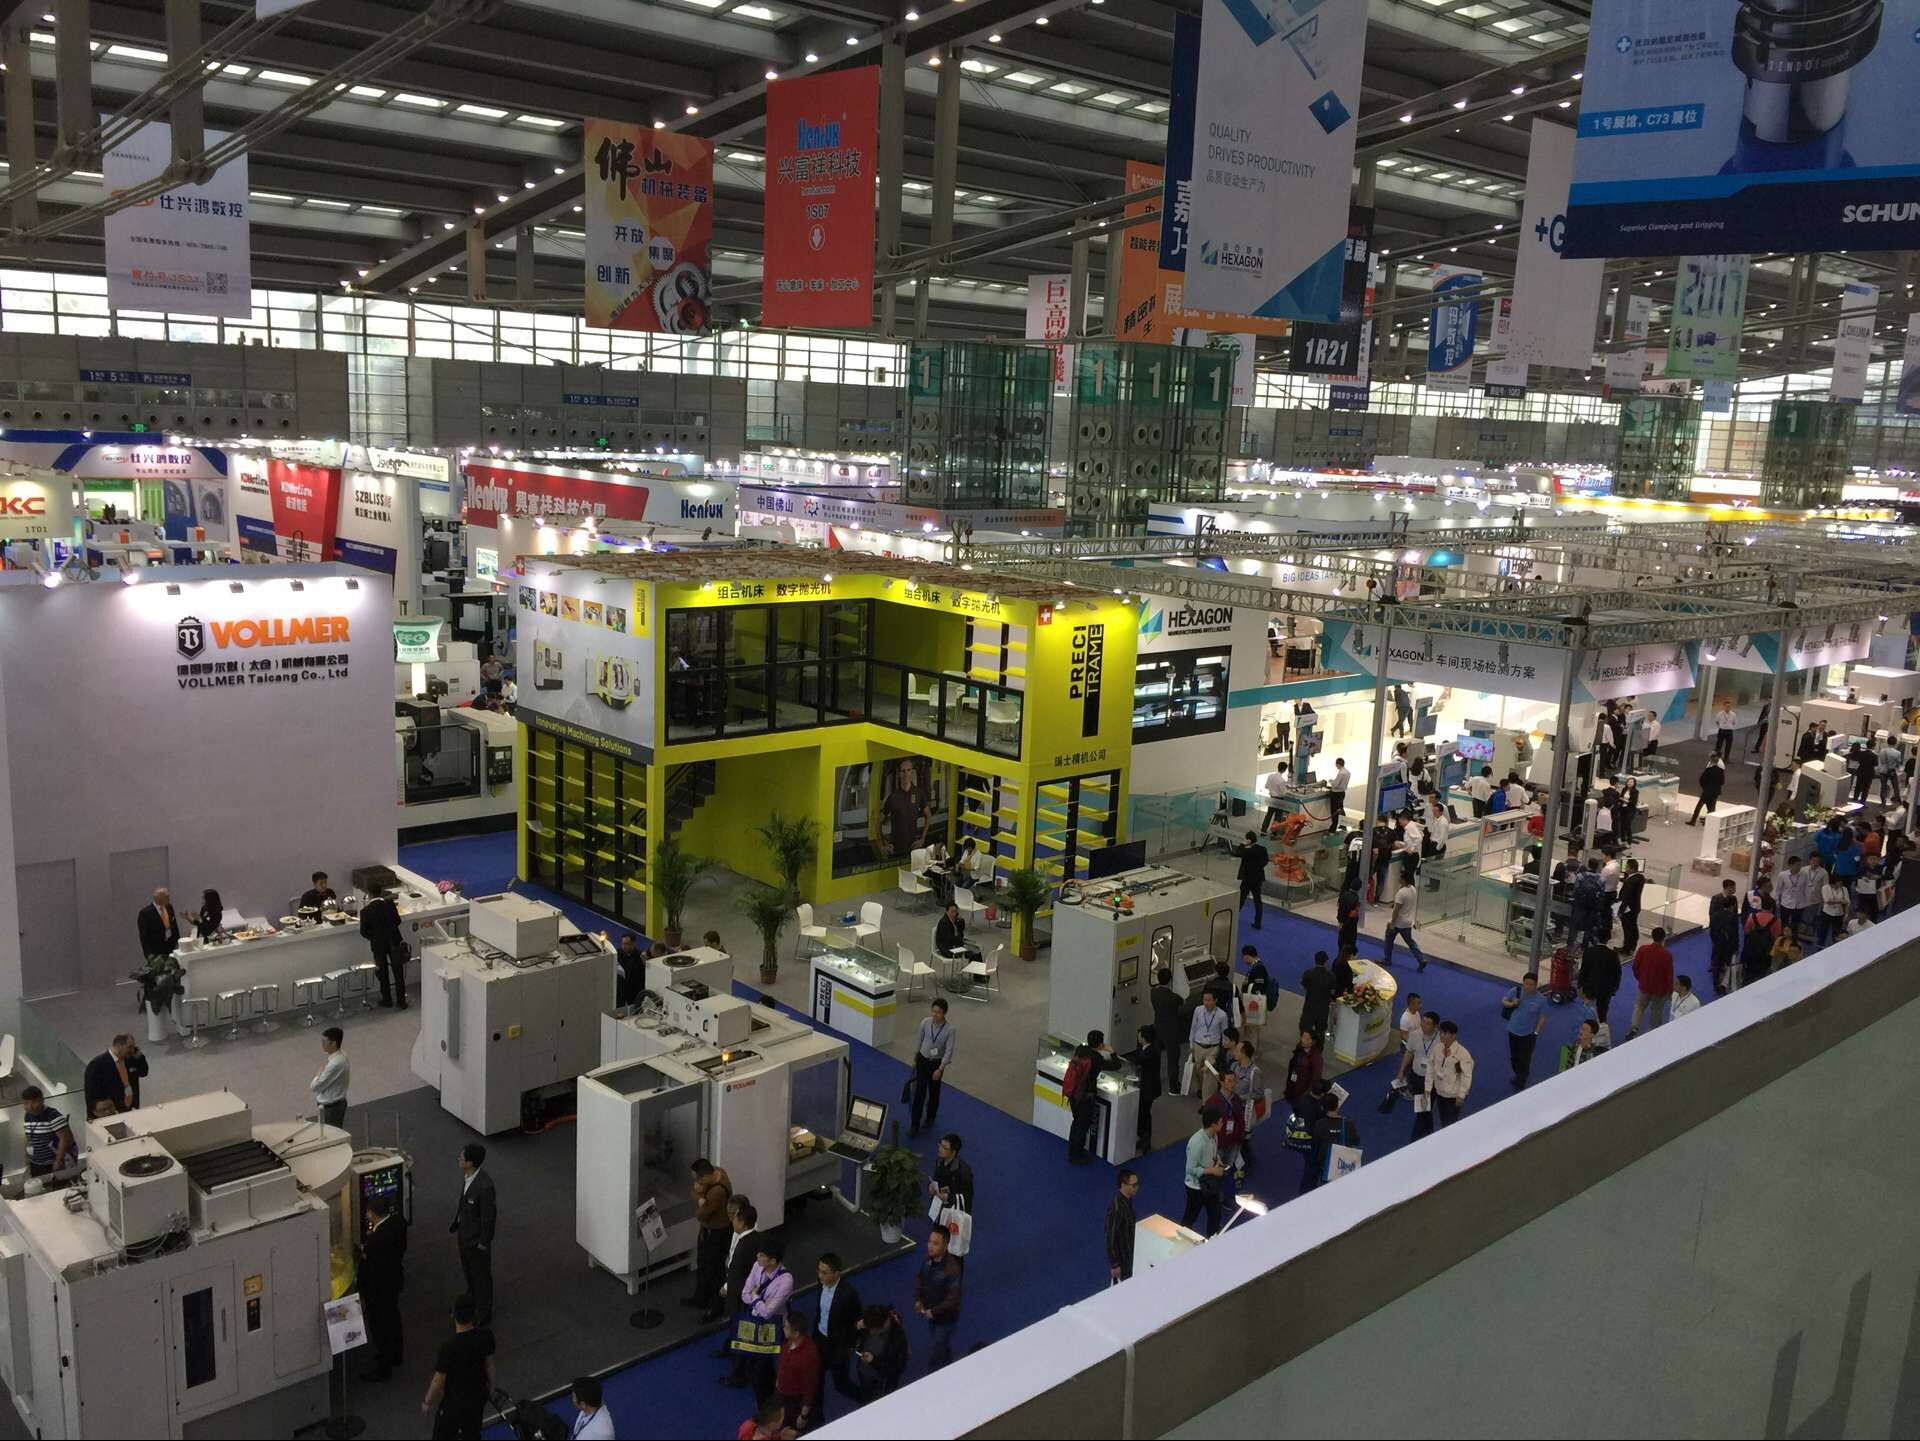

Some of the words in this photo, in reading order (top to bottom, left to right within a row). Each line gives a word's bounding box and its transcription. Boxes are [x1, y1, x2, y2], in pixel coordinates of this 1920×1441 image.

[1209, 122, 1251, 144] QUALITY
[1208, 144, 1245, 165] DRIVES
[1247, 153, 1315, 179] PRODUCTIVITY
[160, 194, 243, 218] 仕兴鸿数控
[615, 225, 644, 244] 开放
[1620, 223, 1646, 233] Superior
[1680, 221, 1694, 230] and
[1221, 252, 1263, 268] HEXAGON
[597, 264, 630, 285] 创新
[1164, 284, 1182, 315] 展
[1305, 337, 1350, 369] 1R21
[919, 355, 930, 389] 1
[1092, 360, 1104, 397] 1
[1149, 361, 1161, 398] 1
[1208, 366, 1221, 401] 1
[1787, 411, 1797, 432] 1
[355, 490, 384, 506] SZBLISS
[680, 499, 723, 519] Henfux
[757, 496, 794, 513] 中国佛山
[1282, 573, 1296, 583] BIG
[1297, 572, 1320, 582] IDEAS
[717, 584, 765, 599] 组合机床
[776, 583, 832, 597] 数字抛光机
[904, 584, 941, 604] 组合机床
[1168, 607, 1233, 628] HEXAGON
[209, 616, 350, 649] VOLLMER
[1070, 625, 1087, 700] PRECI
[1086, 624, 1104, 697] TRAME
[1375, 646, 1425, 662] HXAGON
[1436, 653, 1536, 680] 车间现场检测方案
[1602, 666, 1632, 678] HEXAGO
[178, 674, 245, 690] VOLLMER
[248, 672, 298, 684] Taicang
[301, 670, 326, 681] Co.,
[328, 667, 349, 678] Ltd
[535, 715, 566, 734] Innovative
[567, 726, 599, 747] Machining
[600, 737, 632, 756] Solutions
